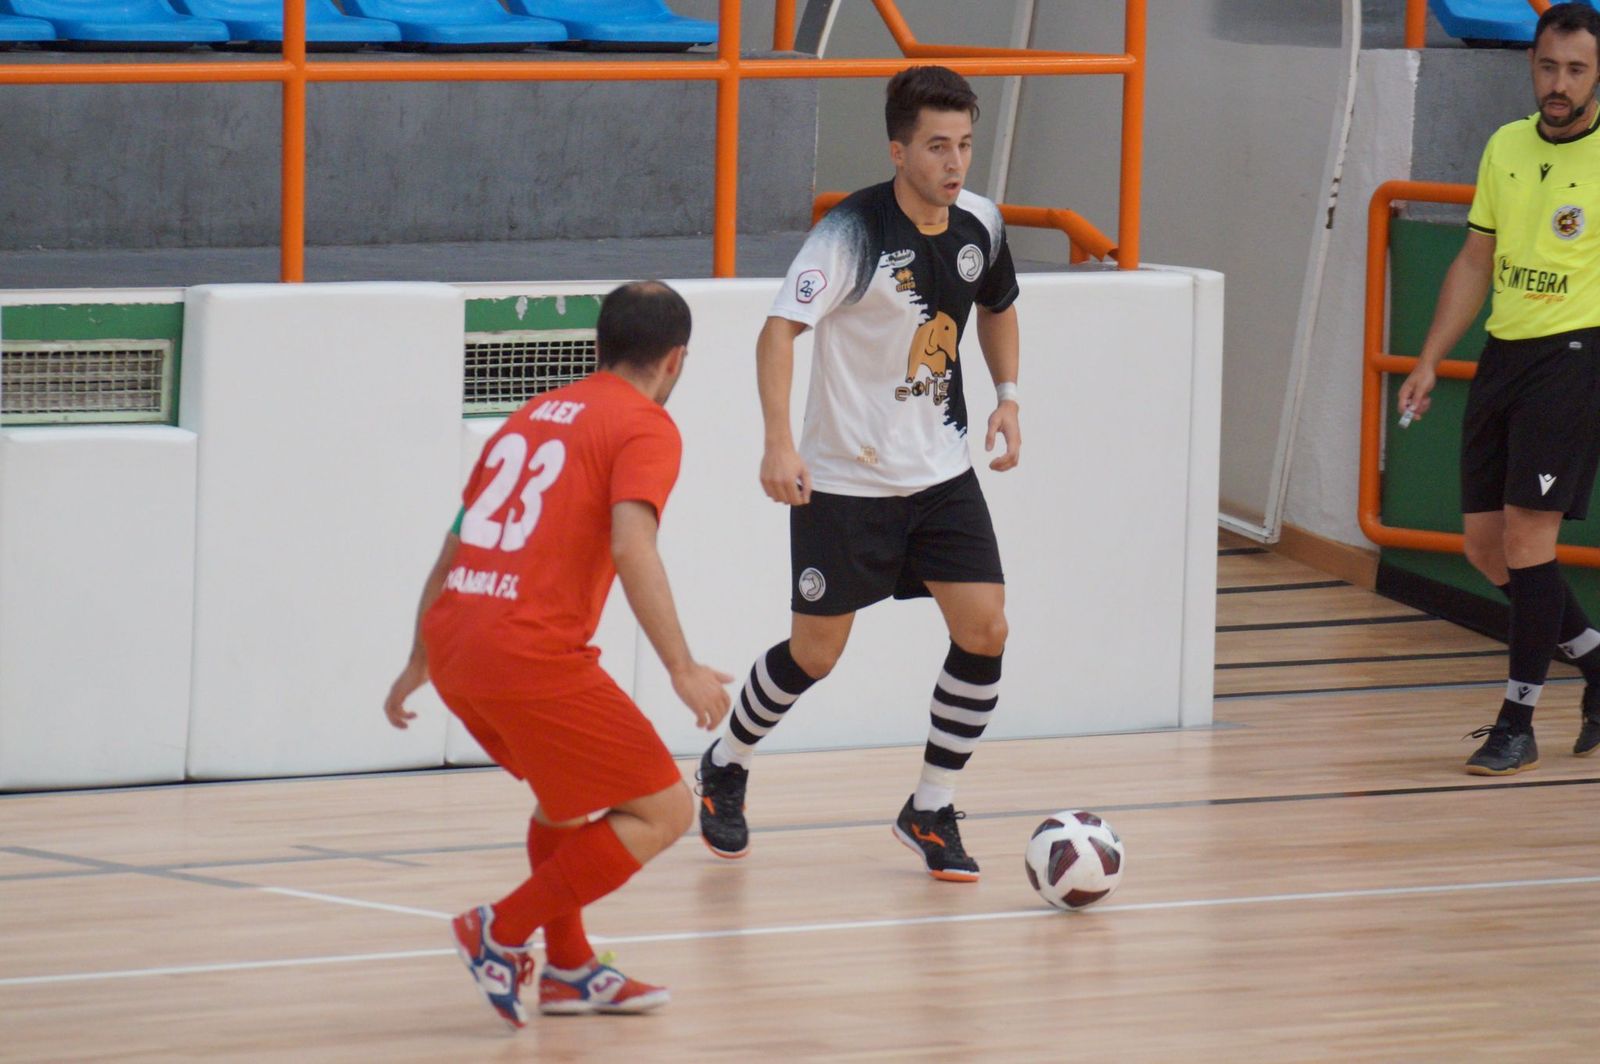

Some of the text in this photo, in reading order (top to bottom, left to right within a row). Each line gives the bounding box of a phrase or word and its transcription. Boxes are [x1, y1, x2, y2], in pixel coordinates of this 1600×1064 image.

[1508, 265, 1568, 293] INTEGRA
[529, 401, 584, 424] ALEX
[461, 433, 565, 552] 23
